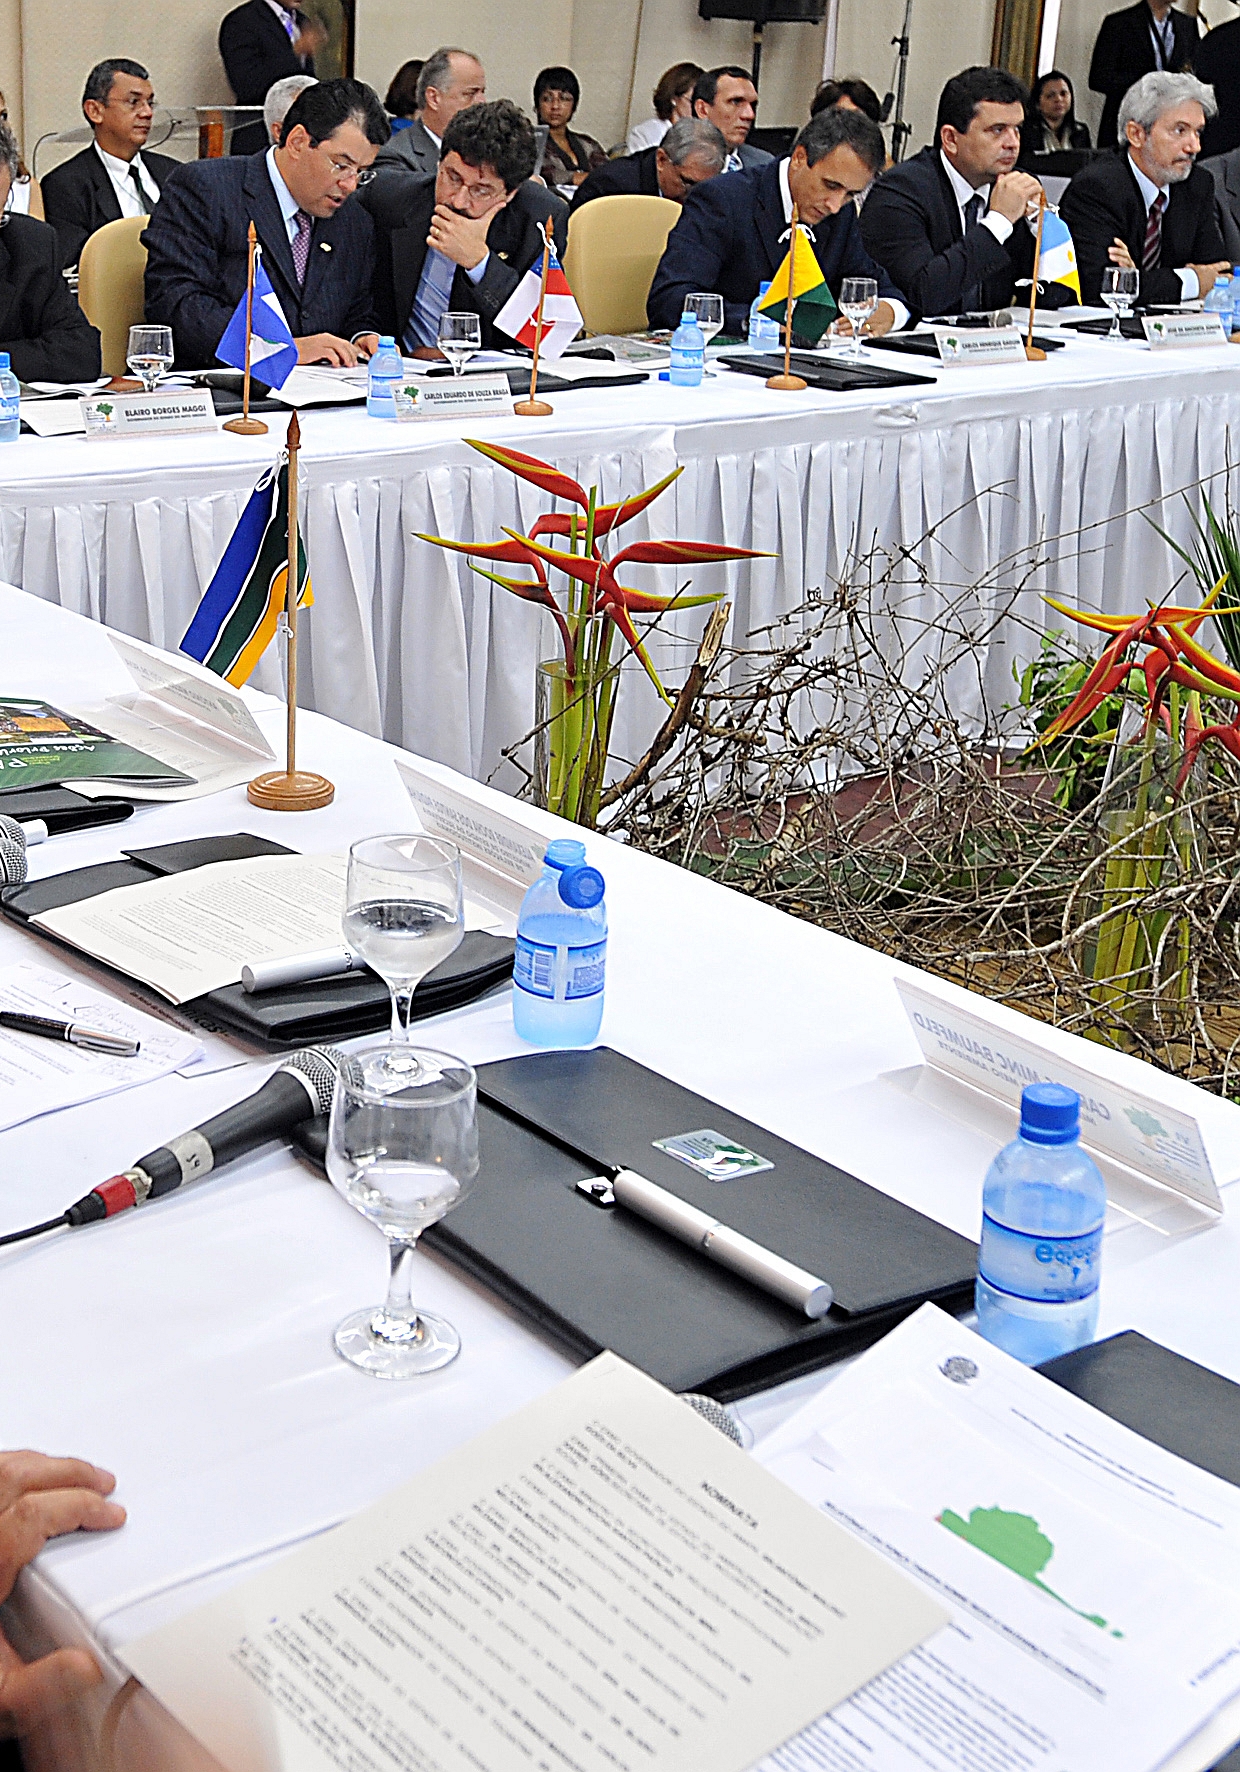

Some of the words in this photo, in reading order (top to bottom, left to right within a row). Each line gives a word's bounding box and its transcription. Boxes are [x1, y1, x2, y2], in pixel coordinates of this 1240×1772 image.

[424, 392, 443, 400] CARLOS
[443, 391, 468, 399] EDUARDO
[468, 390, 475, 398] DE
[476, 389, 492, 397] SOUZA
[492, 388, 509, 396] BRAGA
[125, 408, 150, 417] BLAIRO
[152, 406, 181, 415] BORGES
[182, 405, 207, 413] MAGGI
